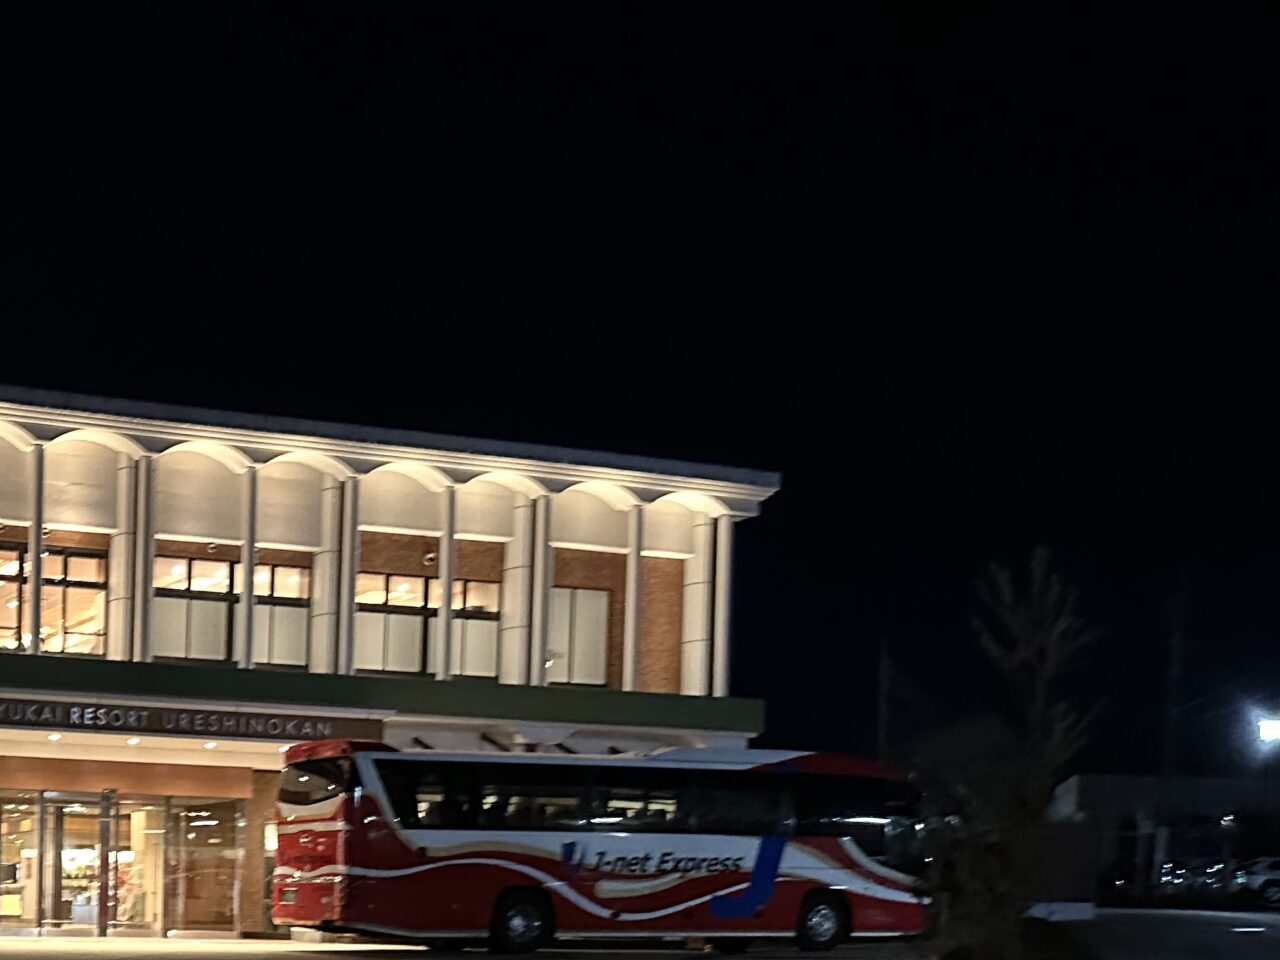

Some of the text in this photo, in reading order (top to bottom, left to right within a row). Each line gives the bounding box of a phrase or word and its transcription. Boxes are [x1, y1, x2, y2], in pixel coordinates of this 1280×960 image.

[70, 707, 149, 728] RESORT
[162, 711, 332, 738] URESHINOKAN
[658, 852, 744, 875] Express
